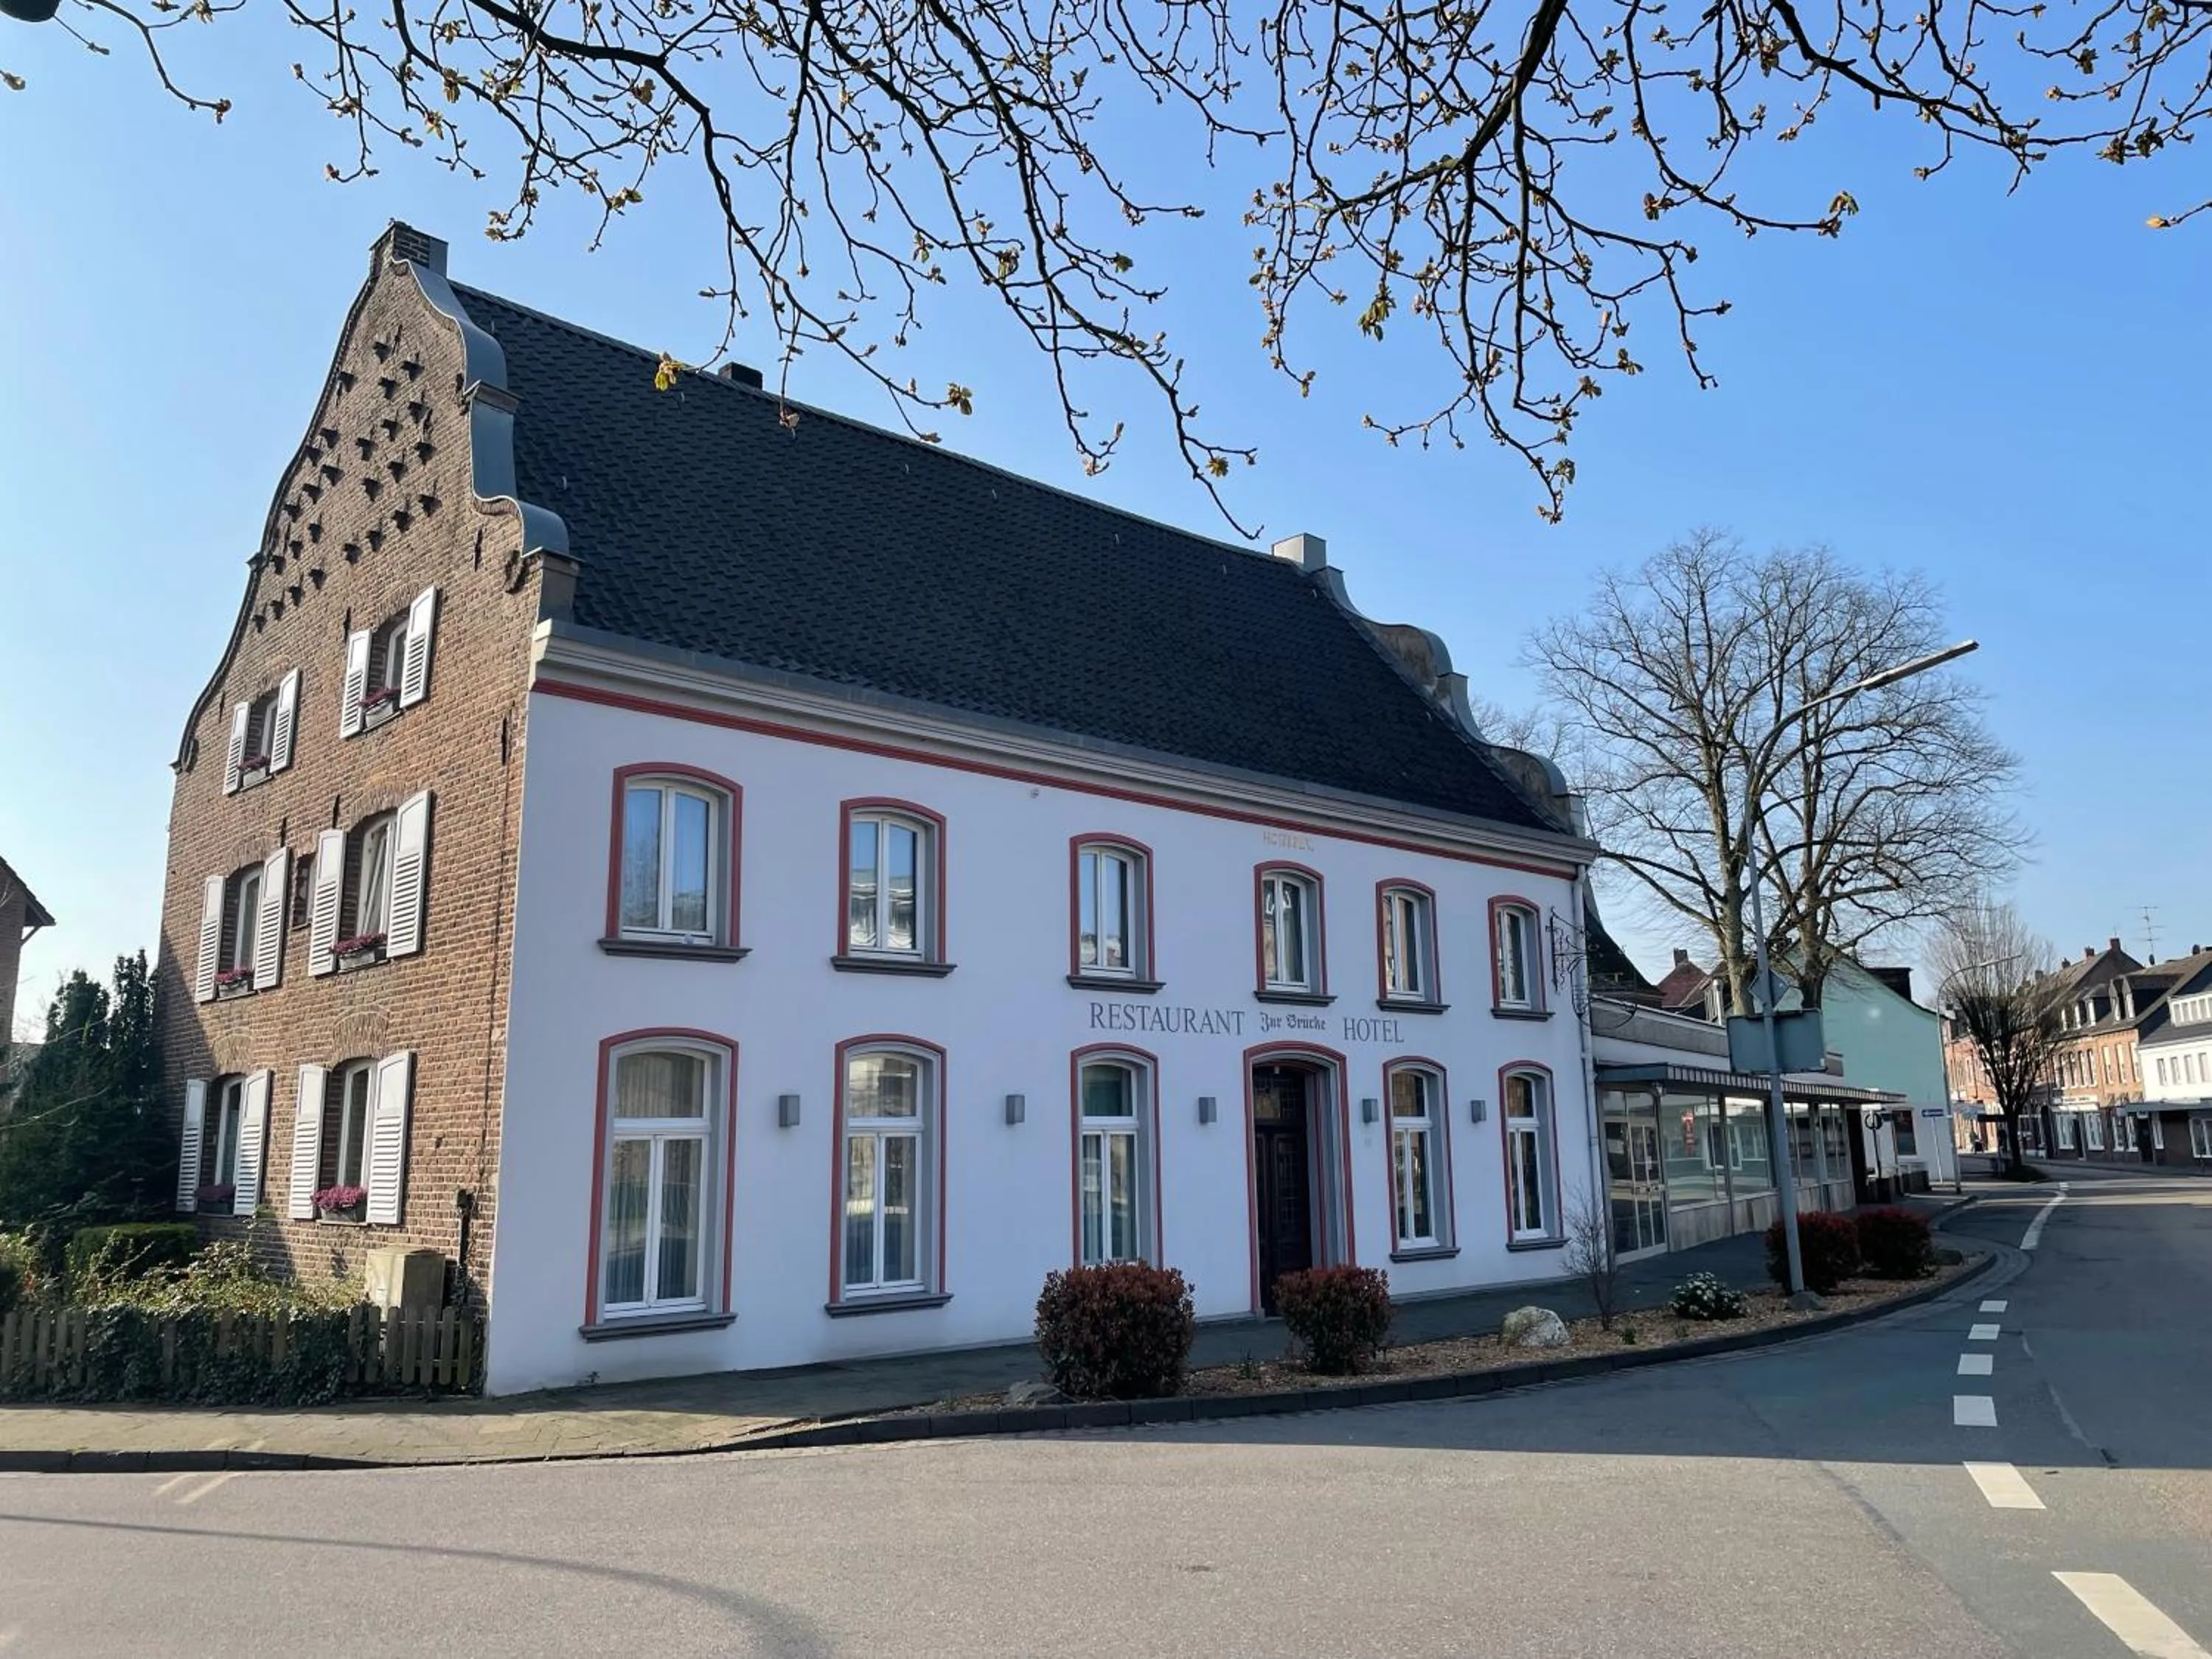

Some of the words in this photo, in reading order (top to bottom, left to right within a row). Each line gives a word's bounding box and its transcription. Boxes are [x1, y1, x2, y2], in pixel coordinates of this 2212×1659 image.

[1090, 1002, 1245, 1035] RESTAURANT
[1286, 1014, 1326, 1031] Brücke
[1343, 1018, 1404, 1043] HOTEL
